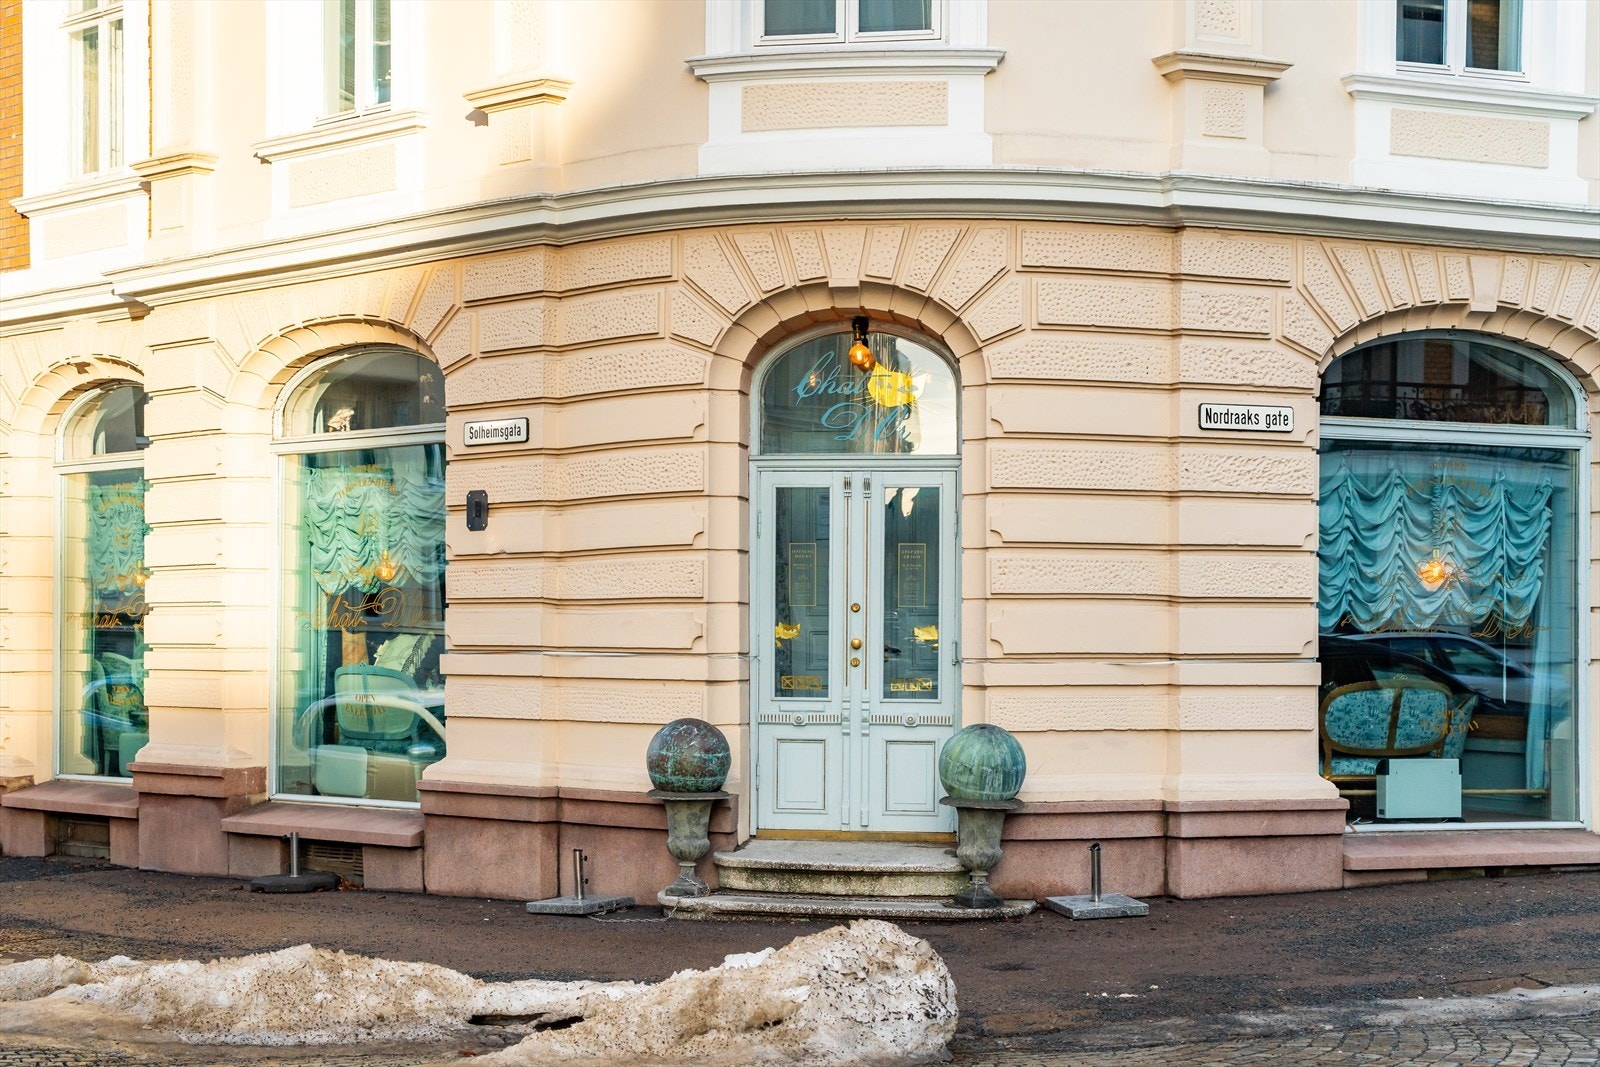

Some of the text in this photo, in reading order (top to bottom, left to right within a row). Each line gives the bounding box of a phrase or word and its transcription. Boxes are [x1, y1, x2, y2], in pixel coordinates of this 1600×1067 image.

[792, 351, 888, 406] Chat
[1205, 407, 1289, 429] Nordraaks gate
[469, 424, 522, 440] Solheimsgata
[355, 693, 376, 703] OPEN
